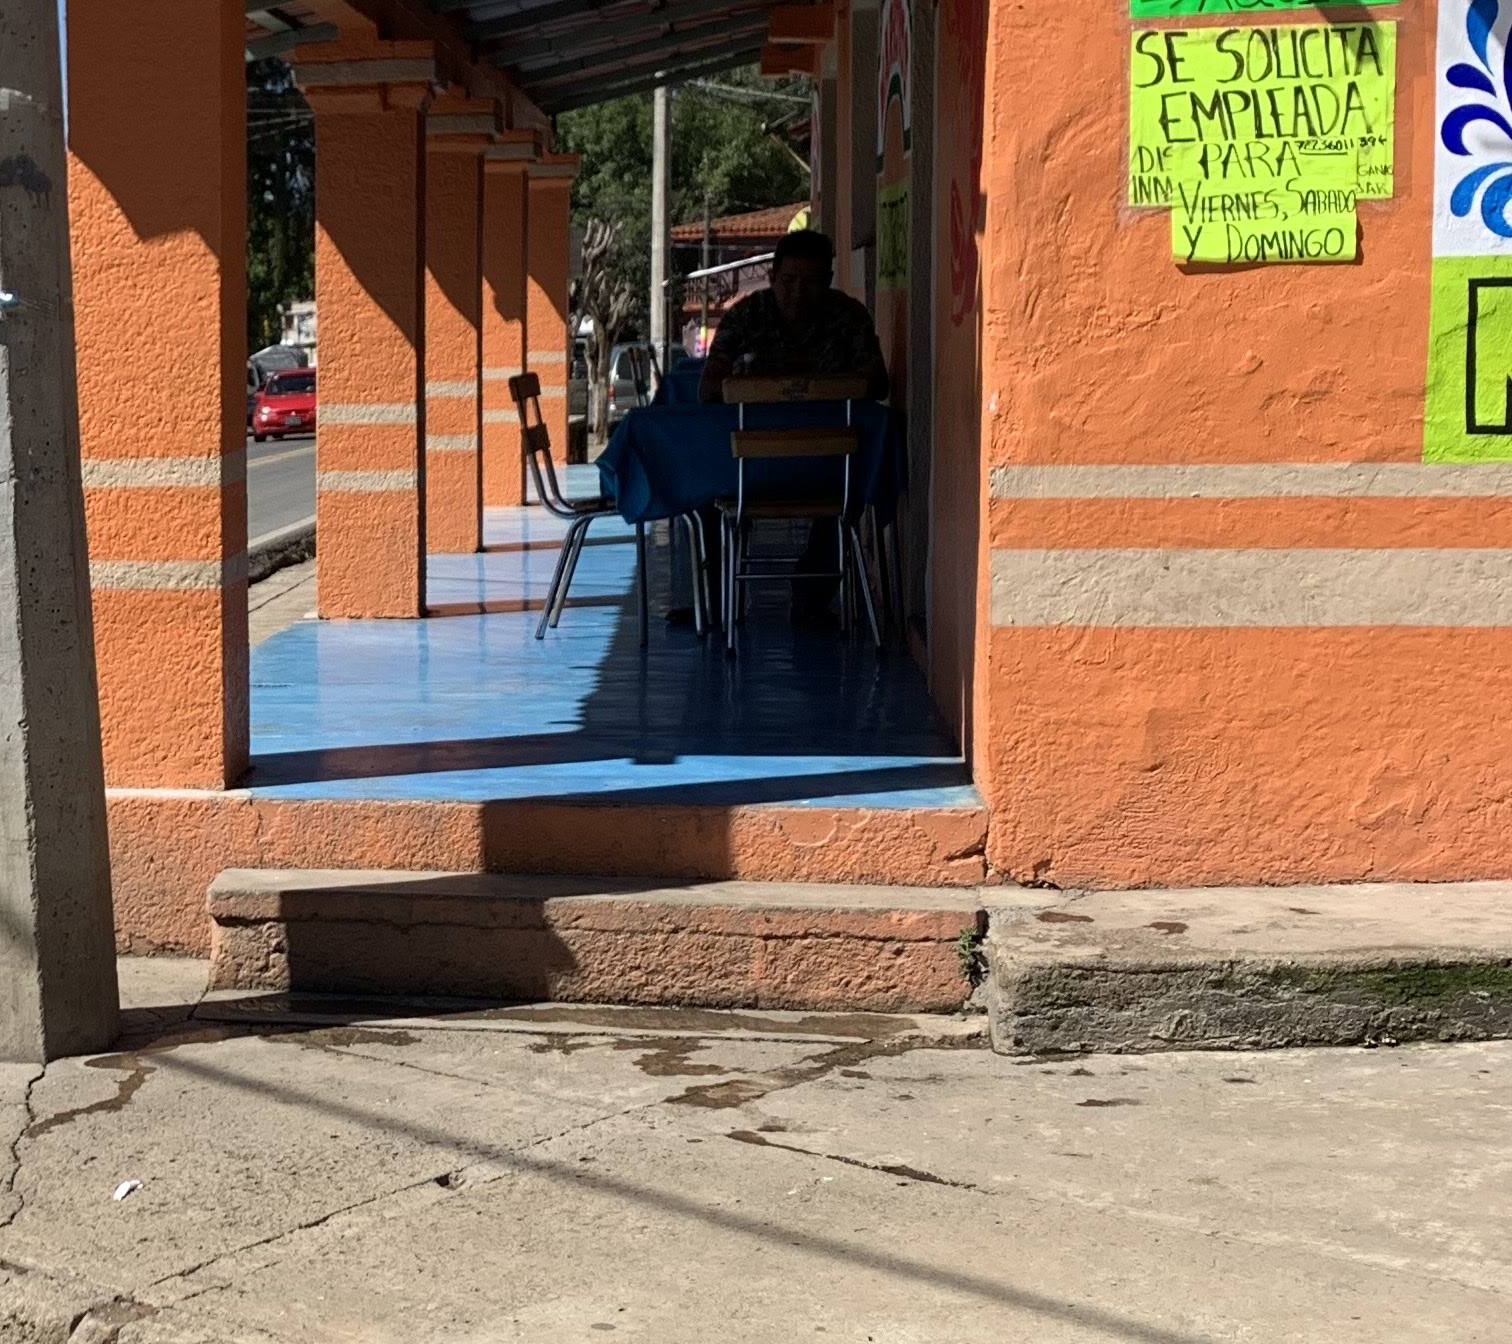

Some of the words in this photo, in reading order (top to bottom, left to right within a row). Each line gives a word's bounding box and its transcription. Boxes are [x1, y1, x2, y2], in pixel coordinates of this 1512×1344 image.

[1135, 30, 1194, 88] SE
[1215, 27, 1383, 83] SOLICITA
[1198, 141, 1301, 179] PARA
[1286, 177, 1356, 216] SABADO
[1182, 225, 1203, 262] Y
[1226, 223, 1345, 264] DOMINGO
